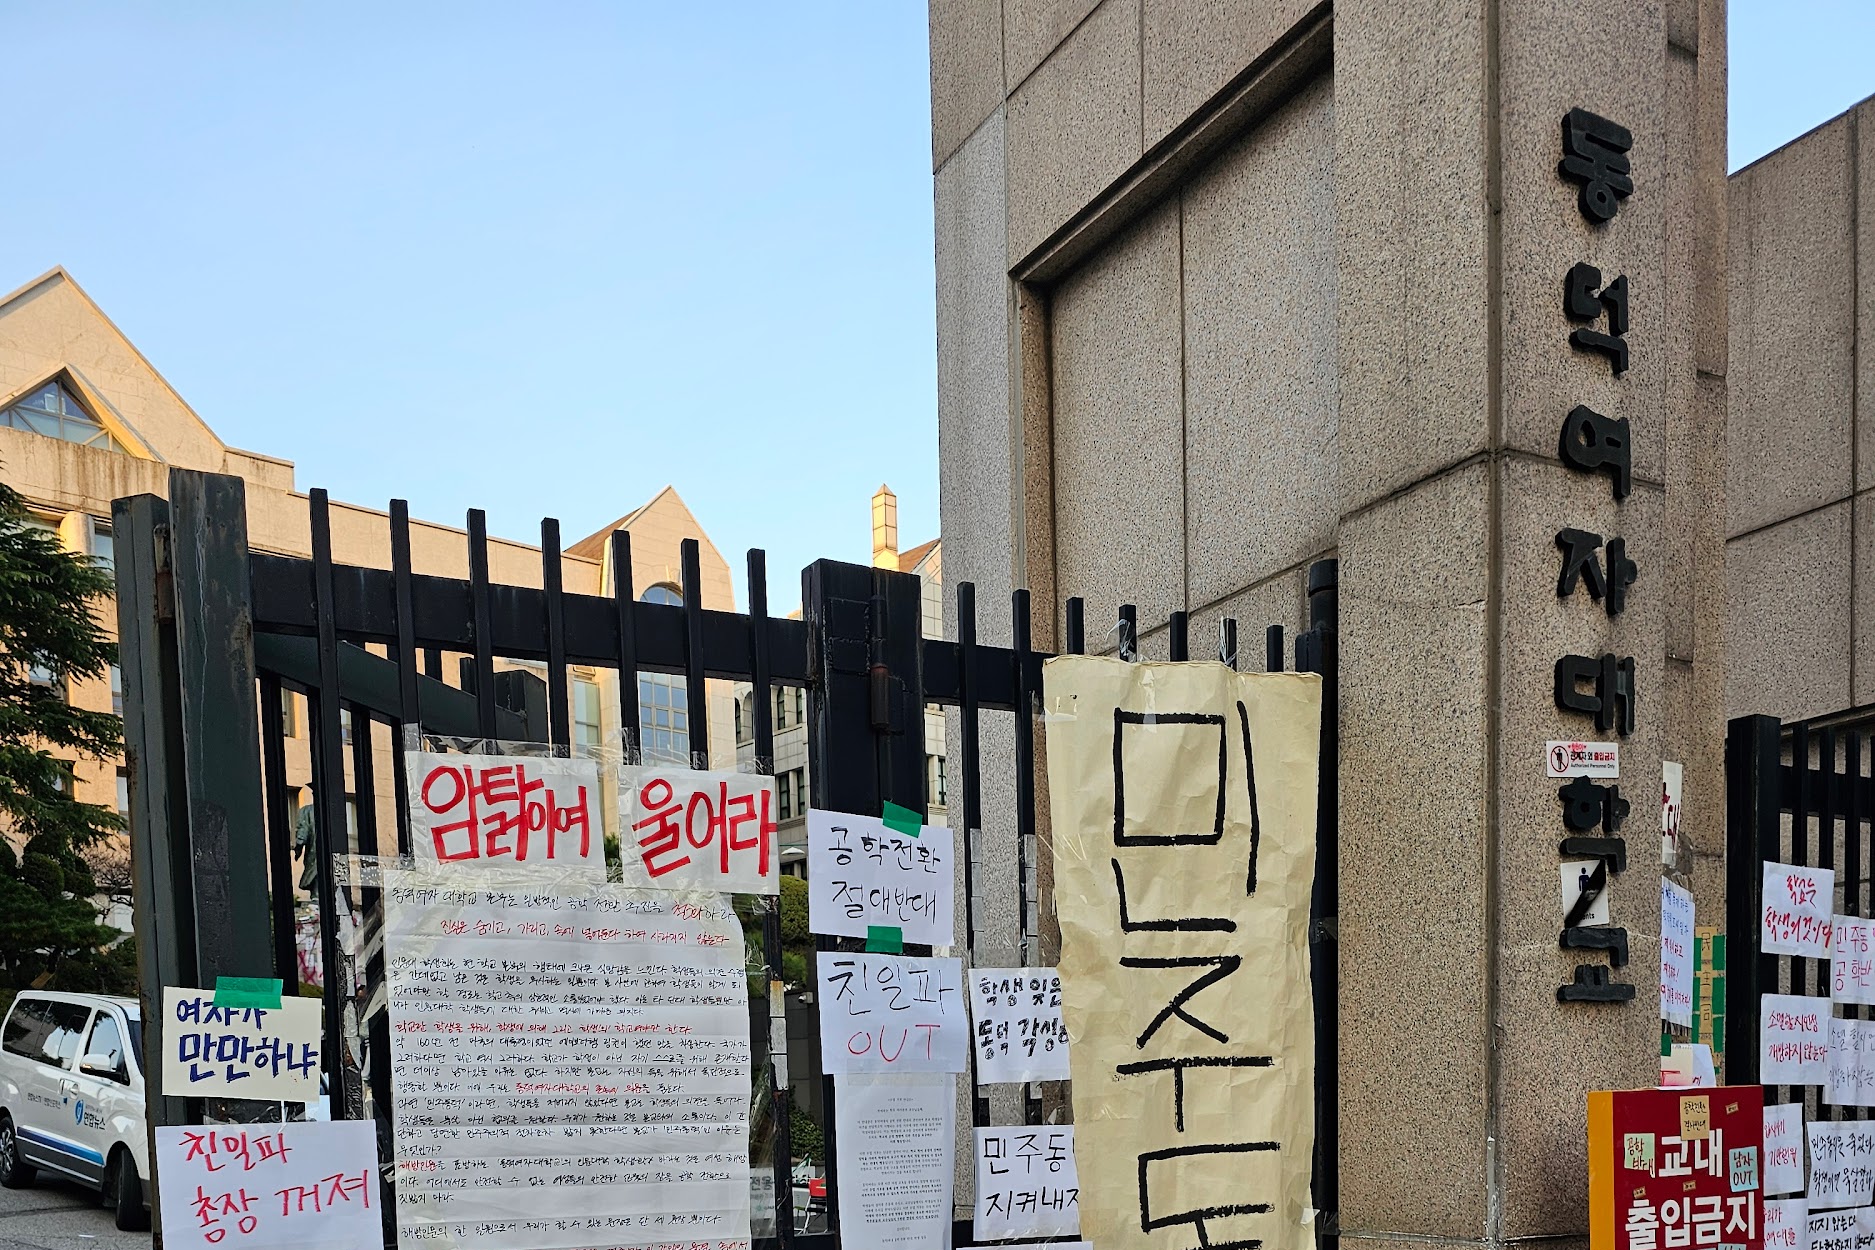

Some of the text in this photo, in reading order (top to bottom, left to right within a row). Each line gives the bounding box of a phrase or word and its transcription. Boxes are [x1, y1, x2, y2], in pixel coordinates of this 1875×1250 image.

[1557, 105, 1638, 1006] 동덕여자대학교
[1594, 752, 1615, 761] 출입금지
[632, 778, 777, 878] 울어라
[828, 826, 940, 873] 공학전환
[832, 881, 936, 924] 절대반대
[1837, 926, 1875, 952] 민주동
[828, 961, 954, 1015] 친일파
[979, 977, 1023, 1006] 학생
[176, 997, 268, 1031] 여자가
[179, 1032, 318, 1084] 만만하냐
[848, 1024, 940, 1061] OUT
[979, 1019, 1008, 1060] 동덕
[84, 1112, 105, 1130] 연합뉴스
[179, 1132, 293, 1172] 친일파
[984, 1133, 1075, 1175] 민주동
[1627, 1137, 1644, 1155] 공학
[1659, 1128, 1722, 1177] 교내
[1734, 1152, 1753, 1168] 남자
[1733, 1171, 1753, 1186] OUT
[195, 1169, 369, 1244] 총장 꺼져
